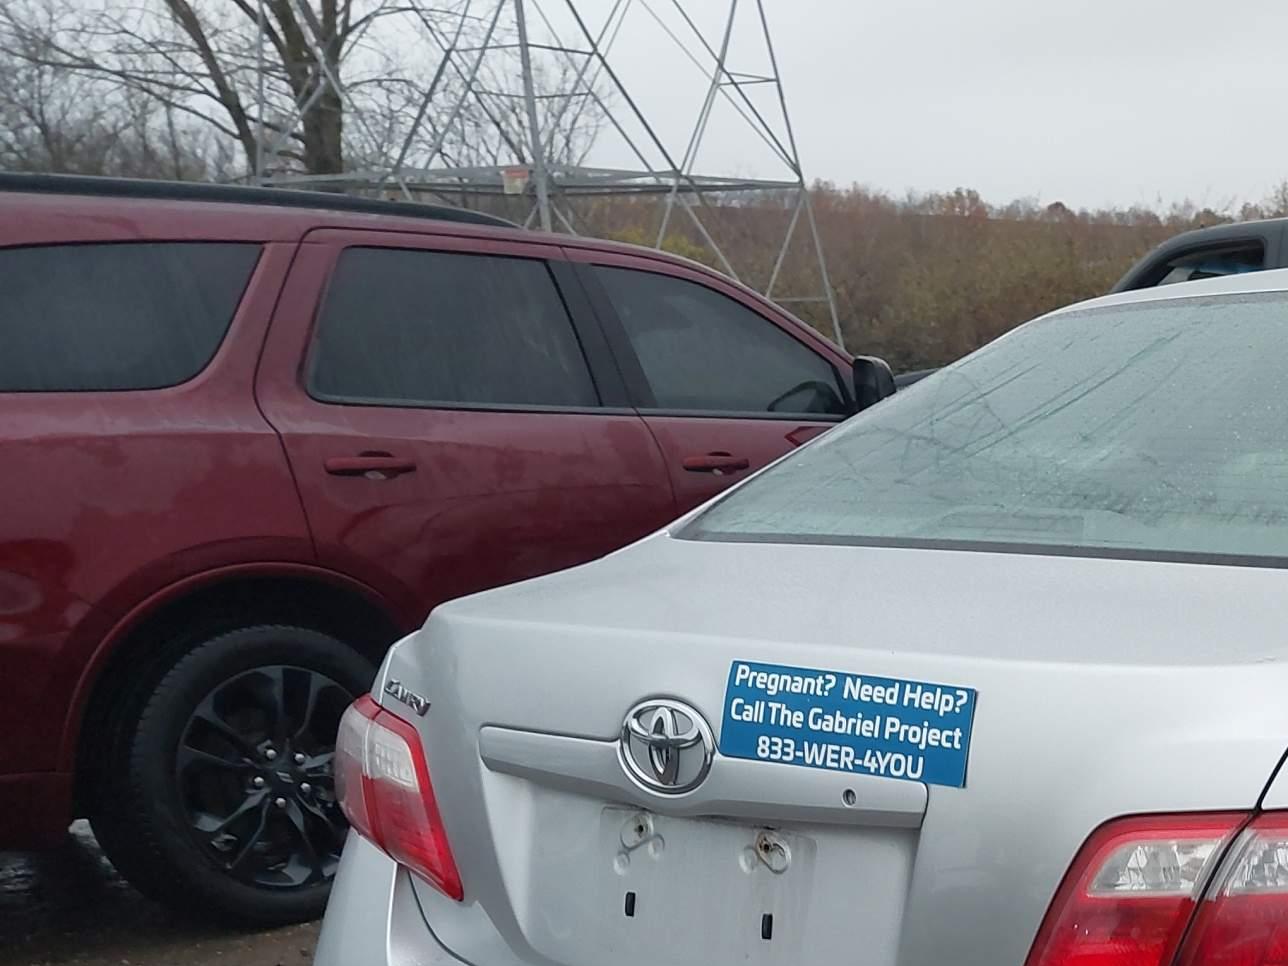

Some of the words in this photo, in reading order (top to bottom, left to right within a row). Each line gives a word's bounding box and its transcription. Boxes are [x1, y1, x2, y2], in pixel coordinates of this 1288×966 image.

[735, 664, 836, 696] Pregnant?
[843, 677, 899, 706] Need
[903, 684, 968, 716] Help?
[731, 698, 764, 724] Call
[768, 703, 804, 729] The
[808, 708, 880, 738] Gabriel
[884, 717, 962, 750] Project
[756, 735, 924, 779] 833-WER-4YOU
